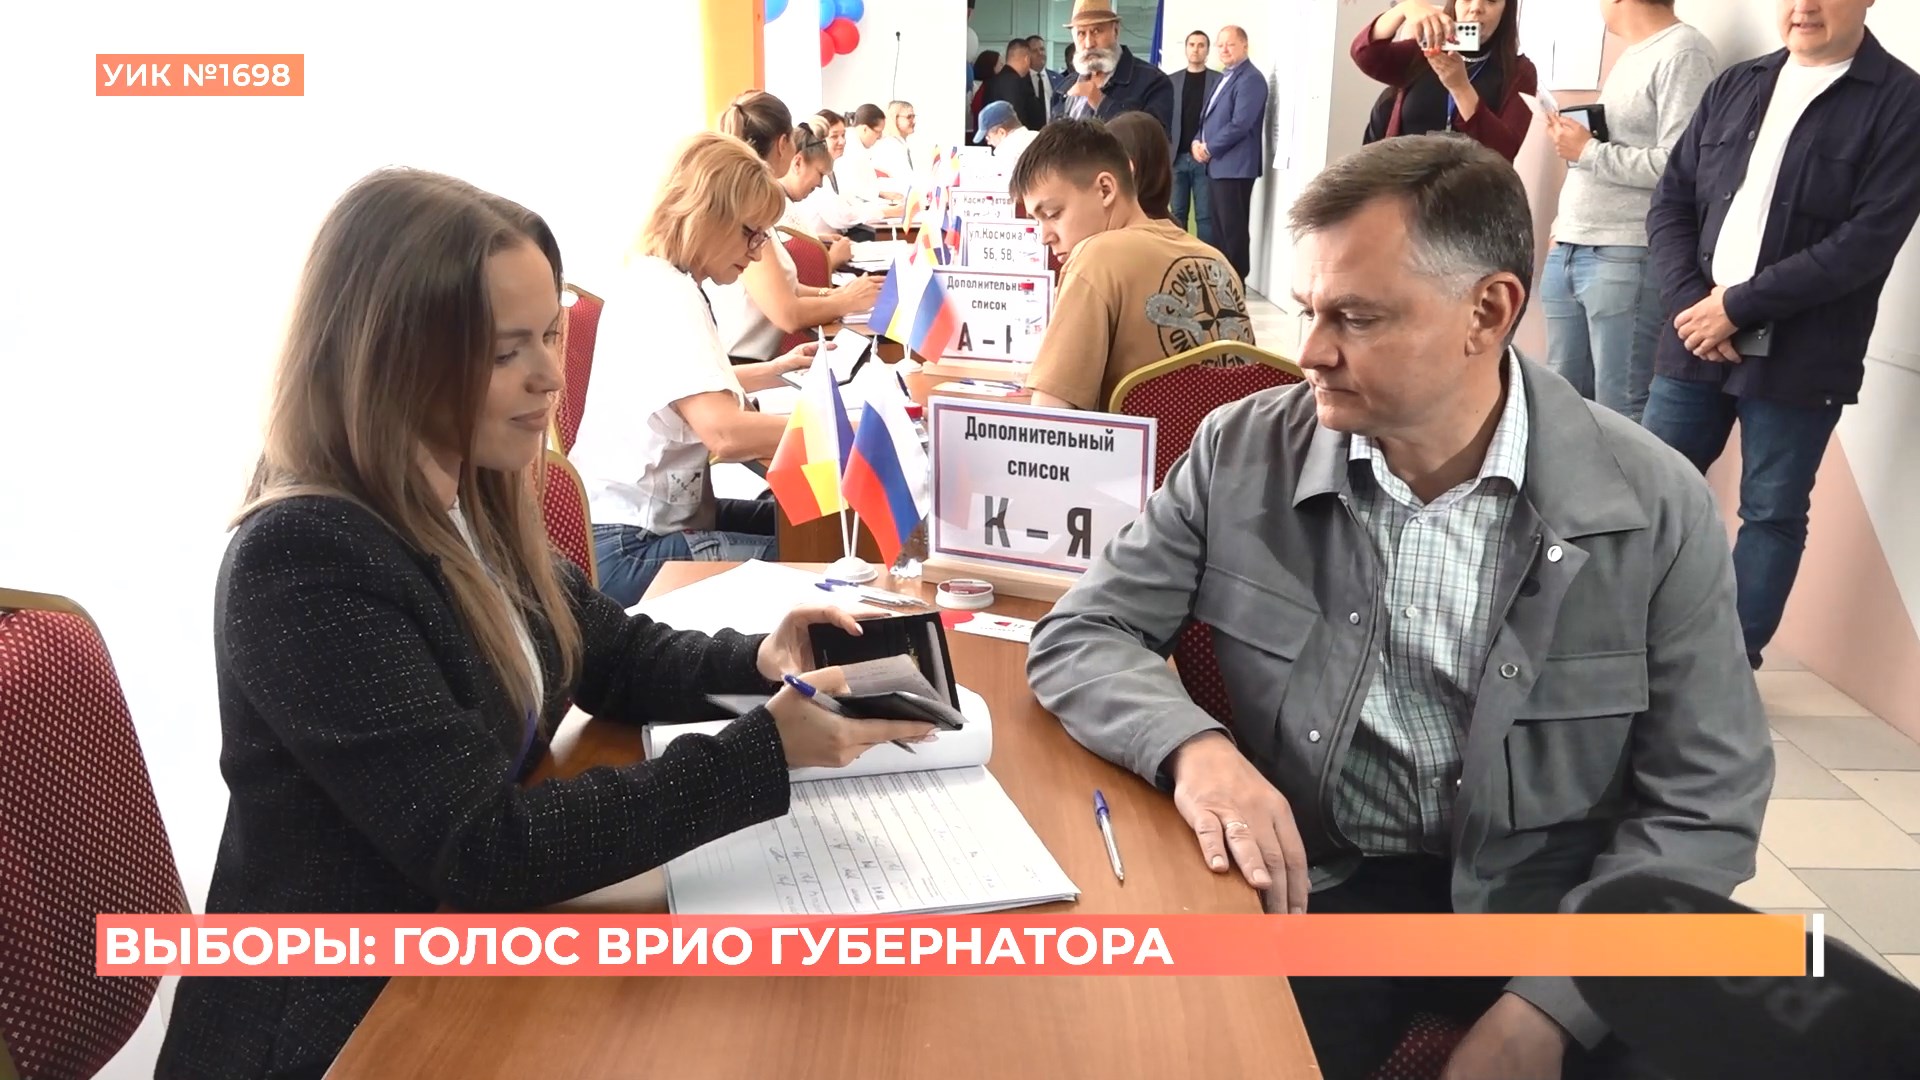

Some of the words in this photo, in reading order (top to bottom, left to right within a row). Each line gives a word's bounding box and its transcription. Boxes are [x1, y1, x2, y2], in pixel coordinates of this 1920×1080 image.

[947, 276, 1034, 292] Дополнительн
[971, 300, 1007, 311] список
[957, 322, 973, 351] А
[965, 415, 1115, 452] Дополнительный
[1007, 460, 1070, 482] список
[984, 495, 1011, 548] К
[1067, 506, 1092, 560] Я
